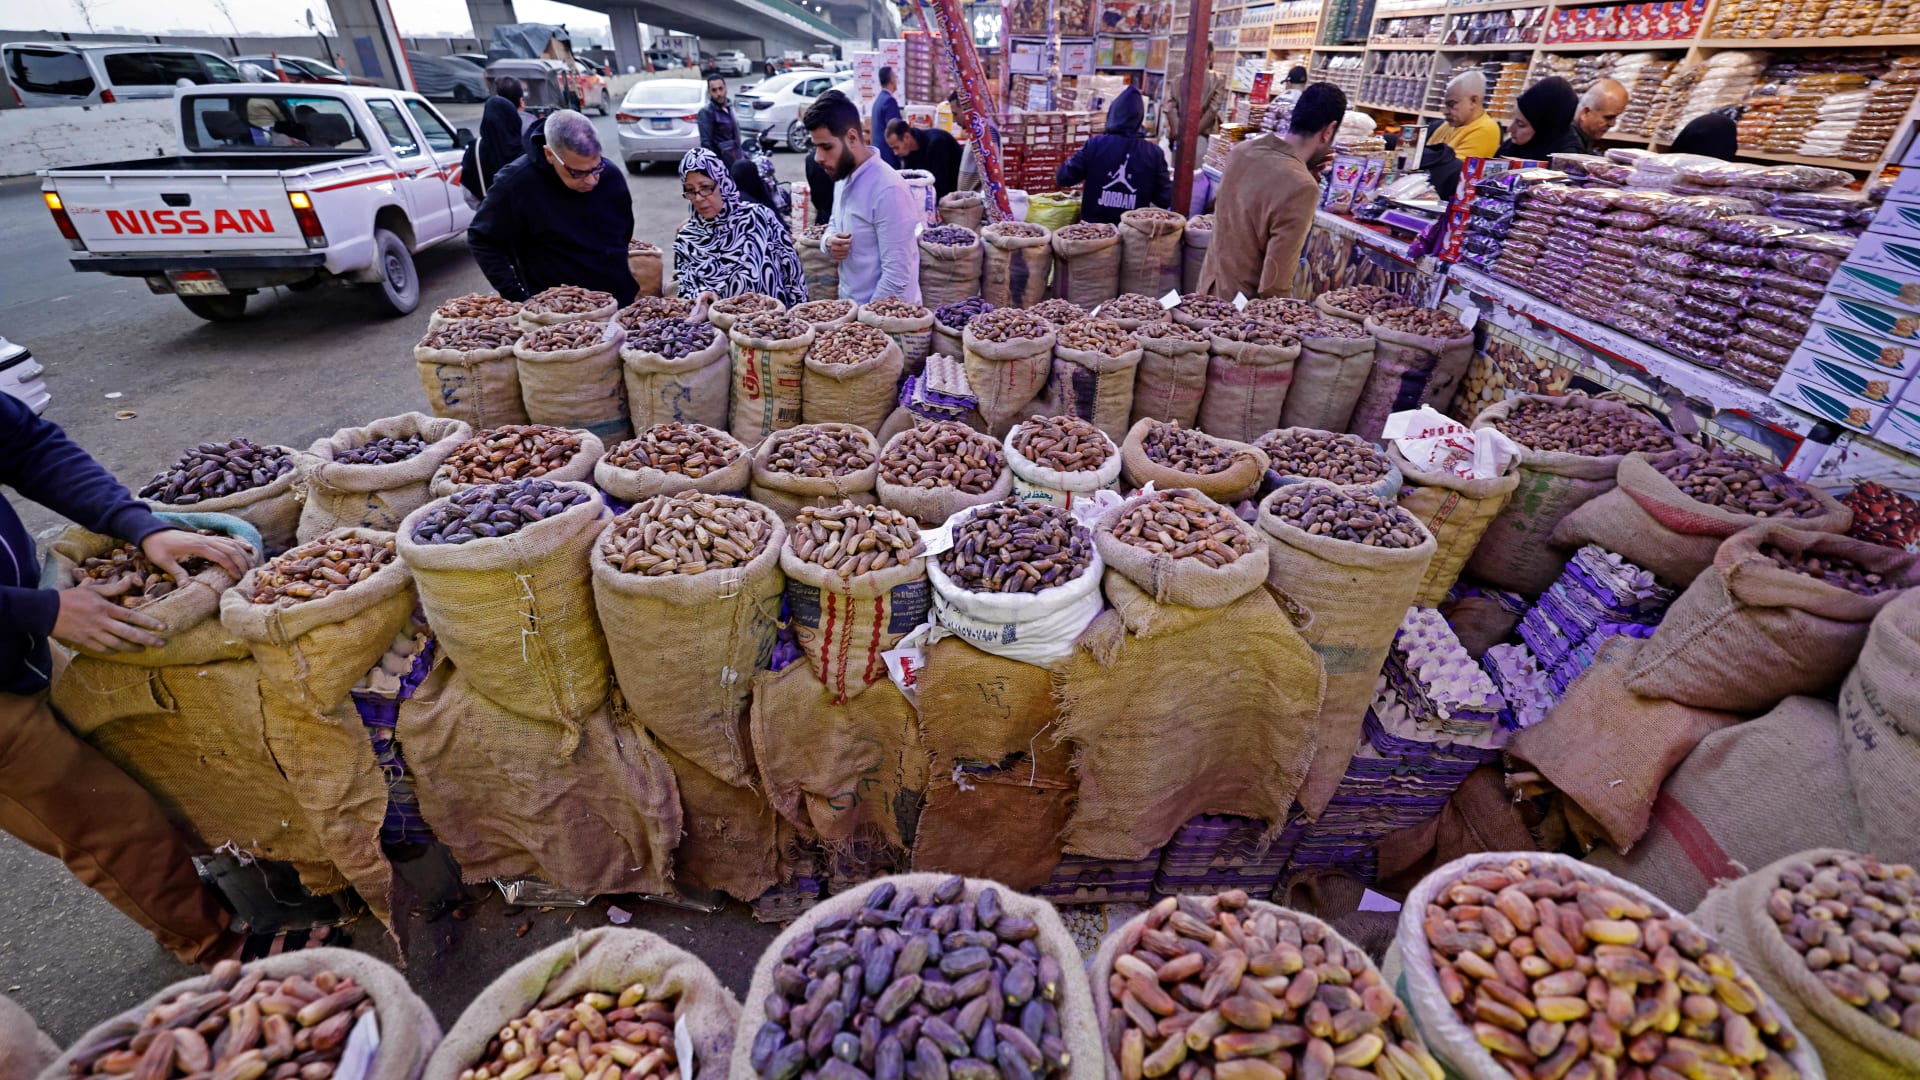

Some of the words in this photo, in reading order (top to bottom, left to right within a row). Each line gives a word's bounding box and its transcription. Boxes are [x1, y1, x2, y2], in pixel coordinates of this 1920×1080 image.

[1097, 190, 1136, 210] JORDAN
[105, 209, 275, 234] NISSAN
[1021, 489, 1032, 502] في
[1032, 489, 1053, 502] يحفظ
